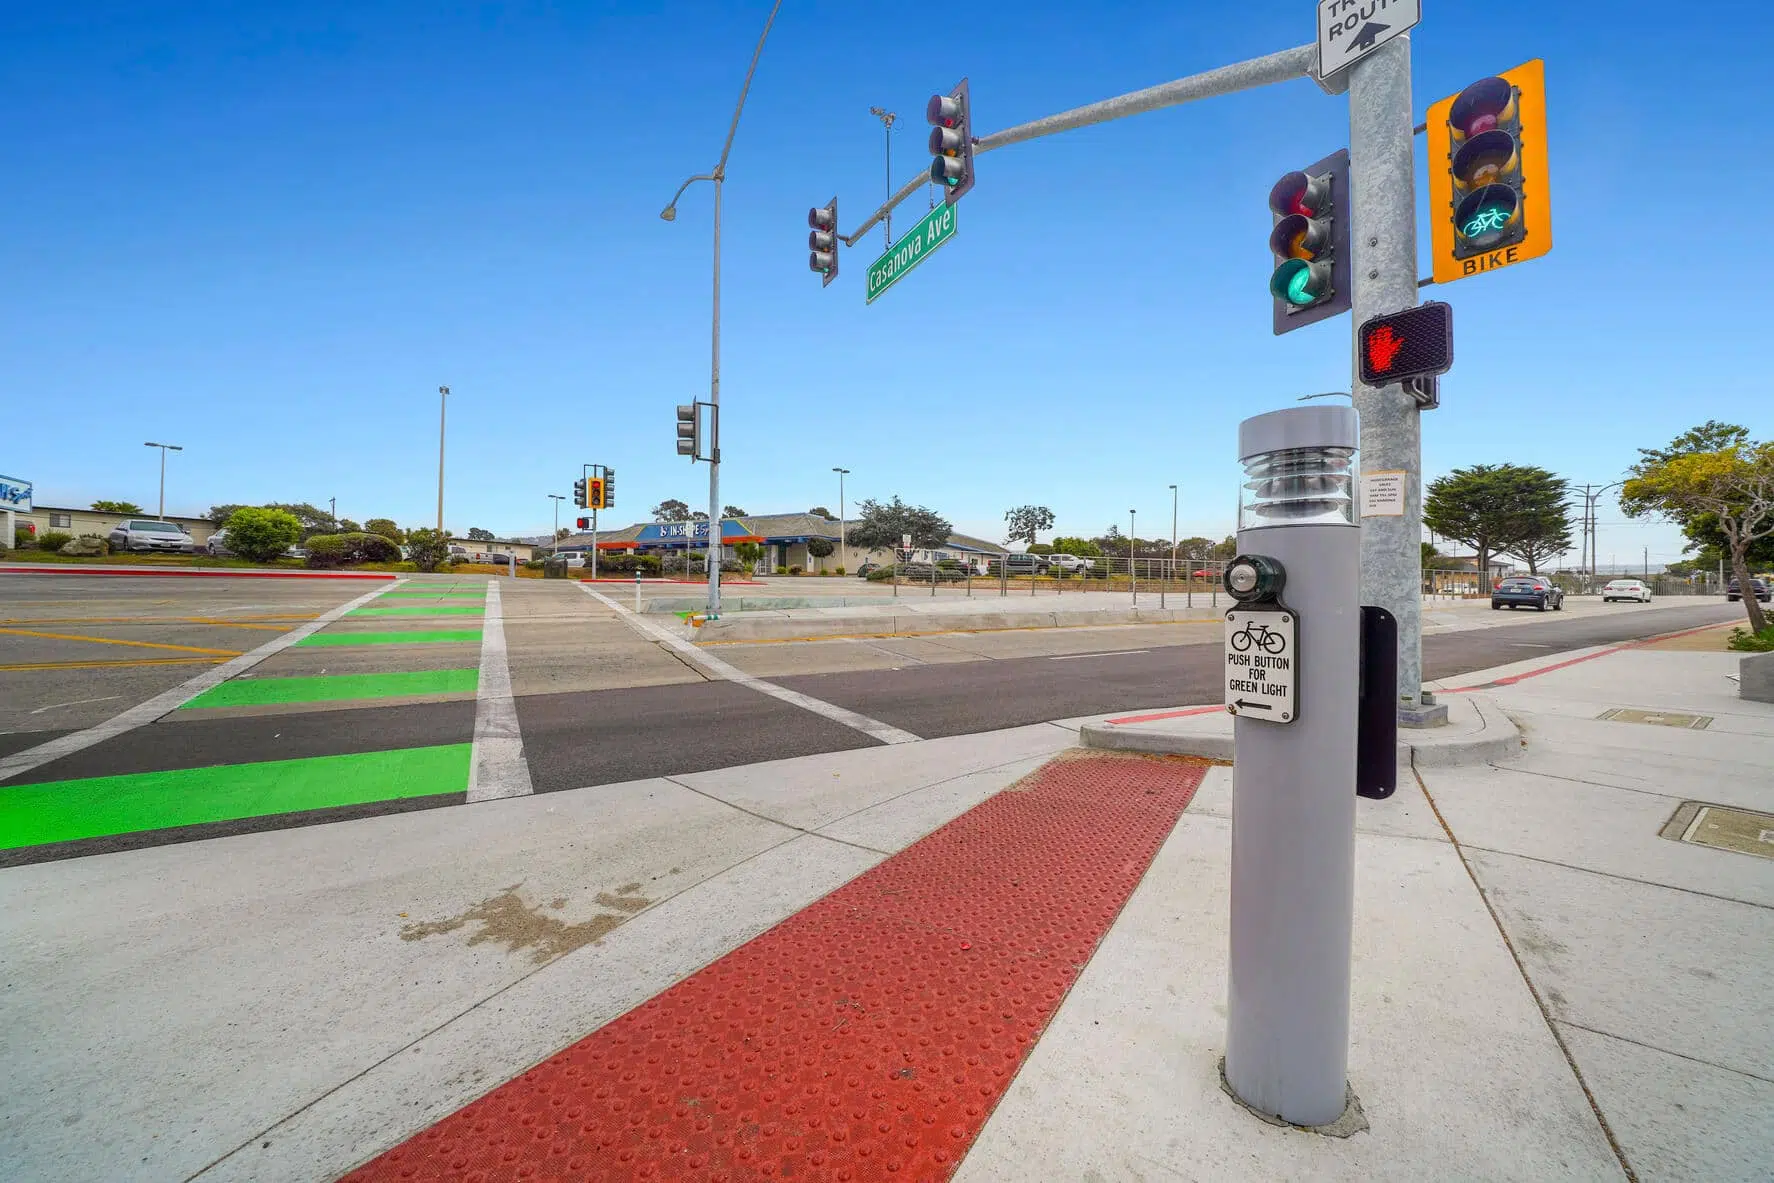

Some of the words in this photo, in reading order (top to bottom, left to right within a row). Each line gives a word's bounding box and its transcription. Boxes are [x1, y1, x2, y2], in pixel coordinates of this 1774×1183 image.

[1329, 0, 1397, 42] ROUT
[869, 234, 922, 292] Casanova
[926, 209, 951, 246] Ave
[1462, 246, 1519, 276] BIKE
[1228, 653, 1251, 667] PUSH
[1254, 655, 1290, 670] BUTTON
[1248, 668, 1266, 681] FOR
[1229, 679, 1258, 693] GREEN
[1261, 682, 1288, 697] LIGHT
